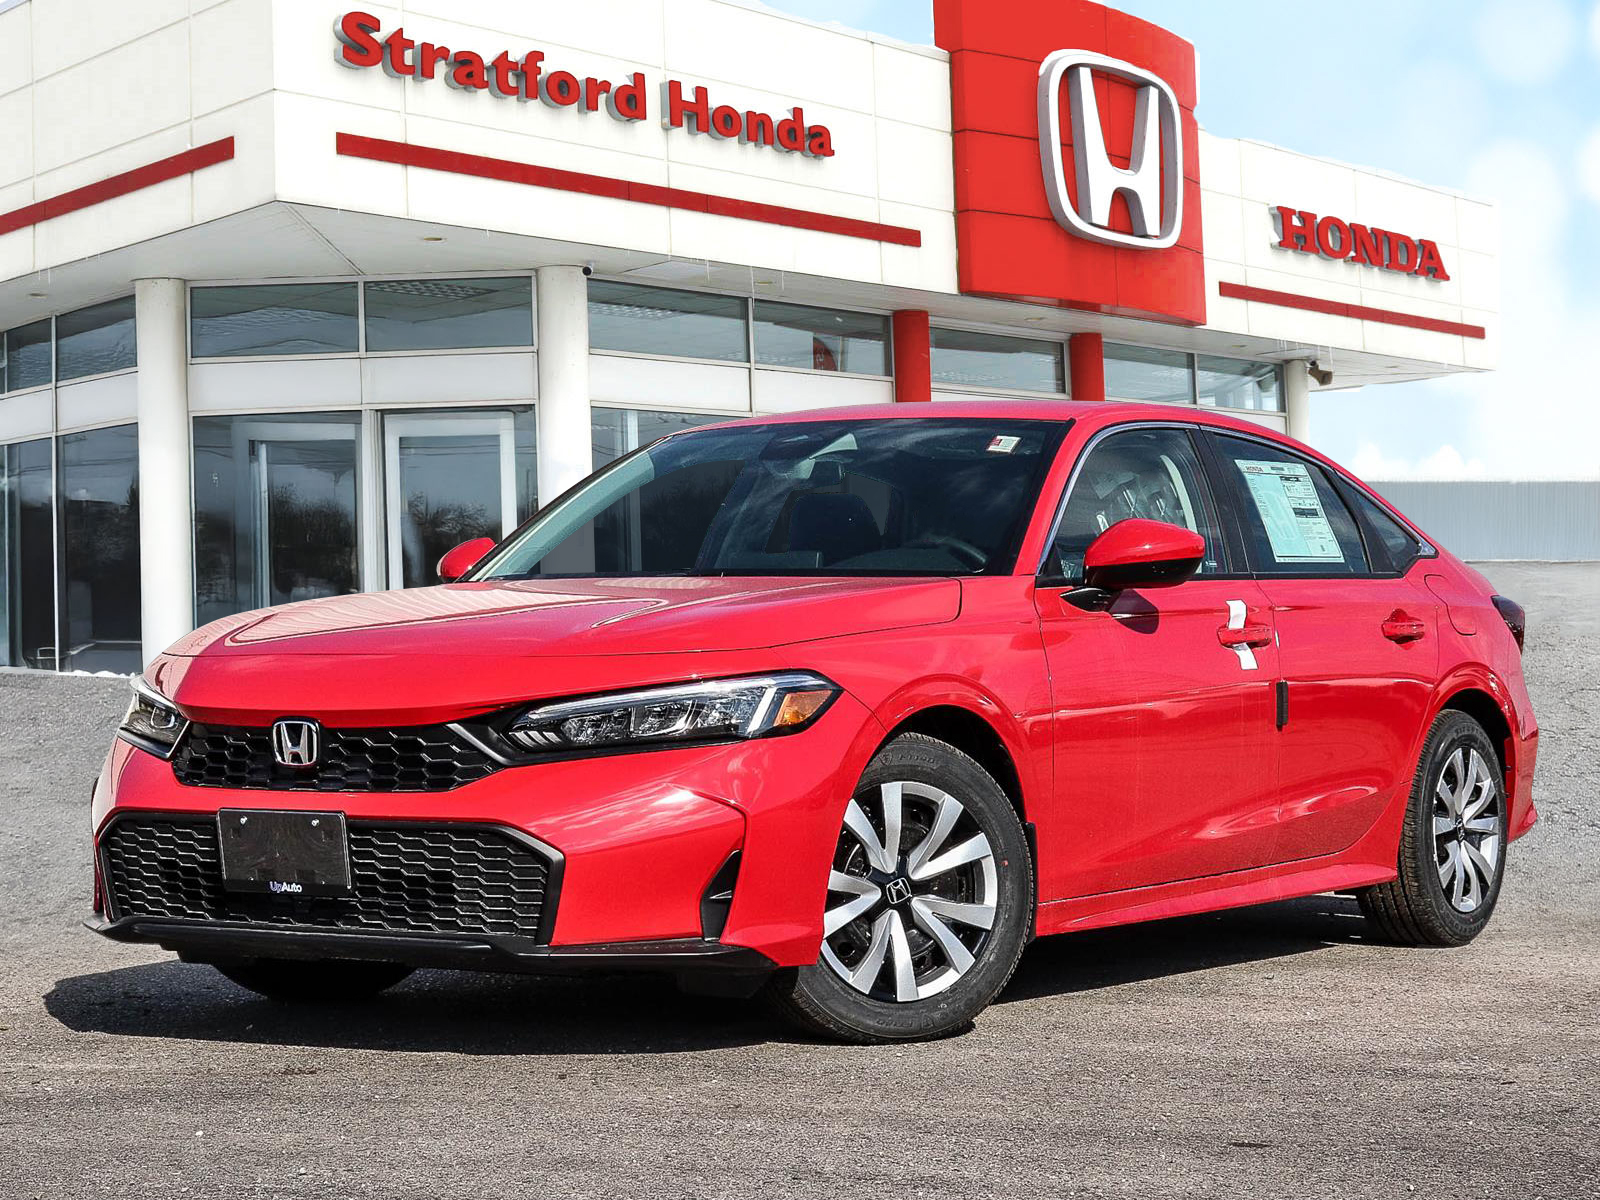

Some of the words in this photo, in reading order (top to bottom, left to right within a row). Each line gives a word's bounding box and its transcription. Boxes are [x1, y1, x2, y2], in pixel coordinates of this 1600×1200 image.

[335, 11, 647, 121] Stratford
[662, 79, 835, 158] Honda
[1270, 205, 1451, 282] HONDA
[269, 880, 303, 893] UpAuto
